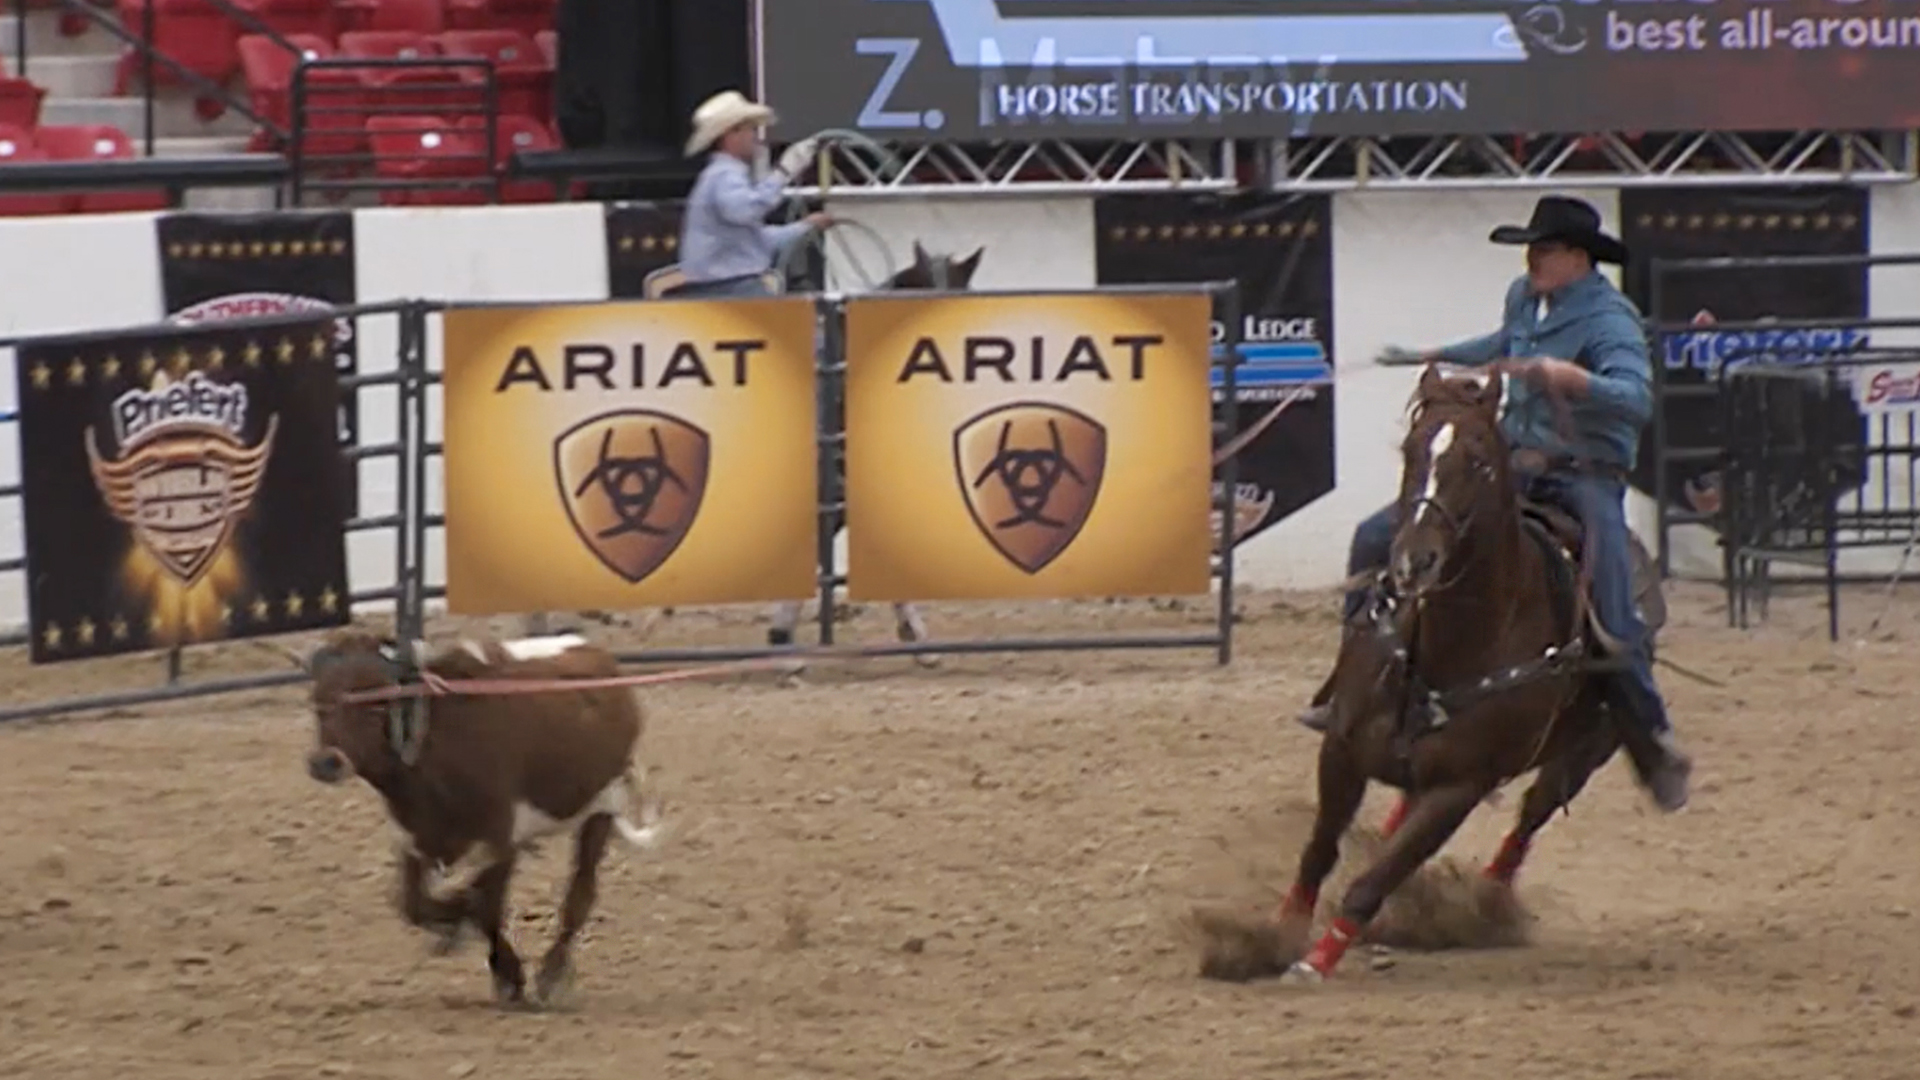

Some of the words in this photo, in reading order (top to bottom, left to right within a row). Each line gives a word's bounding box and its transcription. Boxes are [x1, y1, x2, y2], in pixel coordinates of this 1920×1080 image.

[1607, 11, 1706, 49] best
[855, 37, 945, 130] Z.
[1000, 82, 1119, 116] HORSE
[1130, 80, 1468, 113] TRANSPORTATION
[495, 339, 768, 393] ARIAT
[895, 335, 1164, 384] ARIAT
